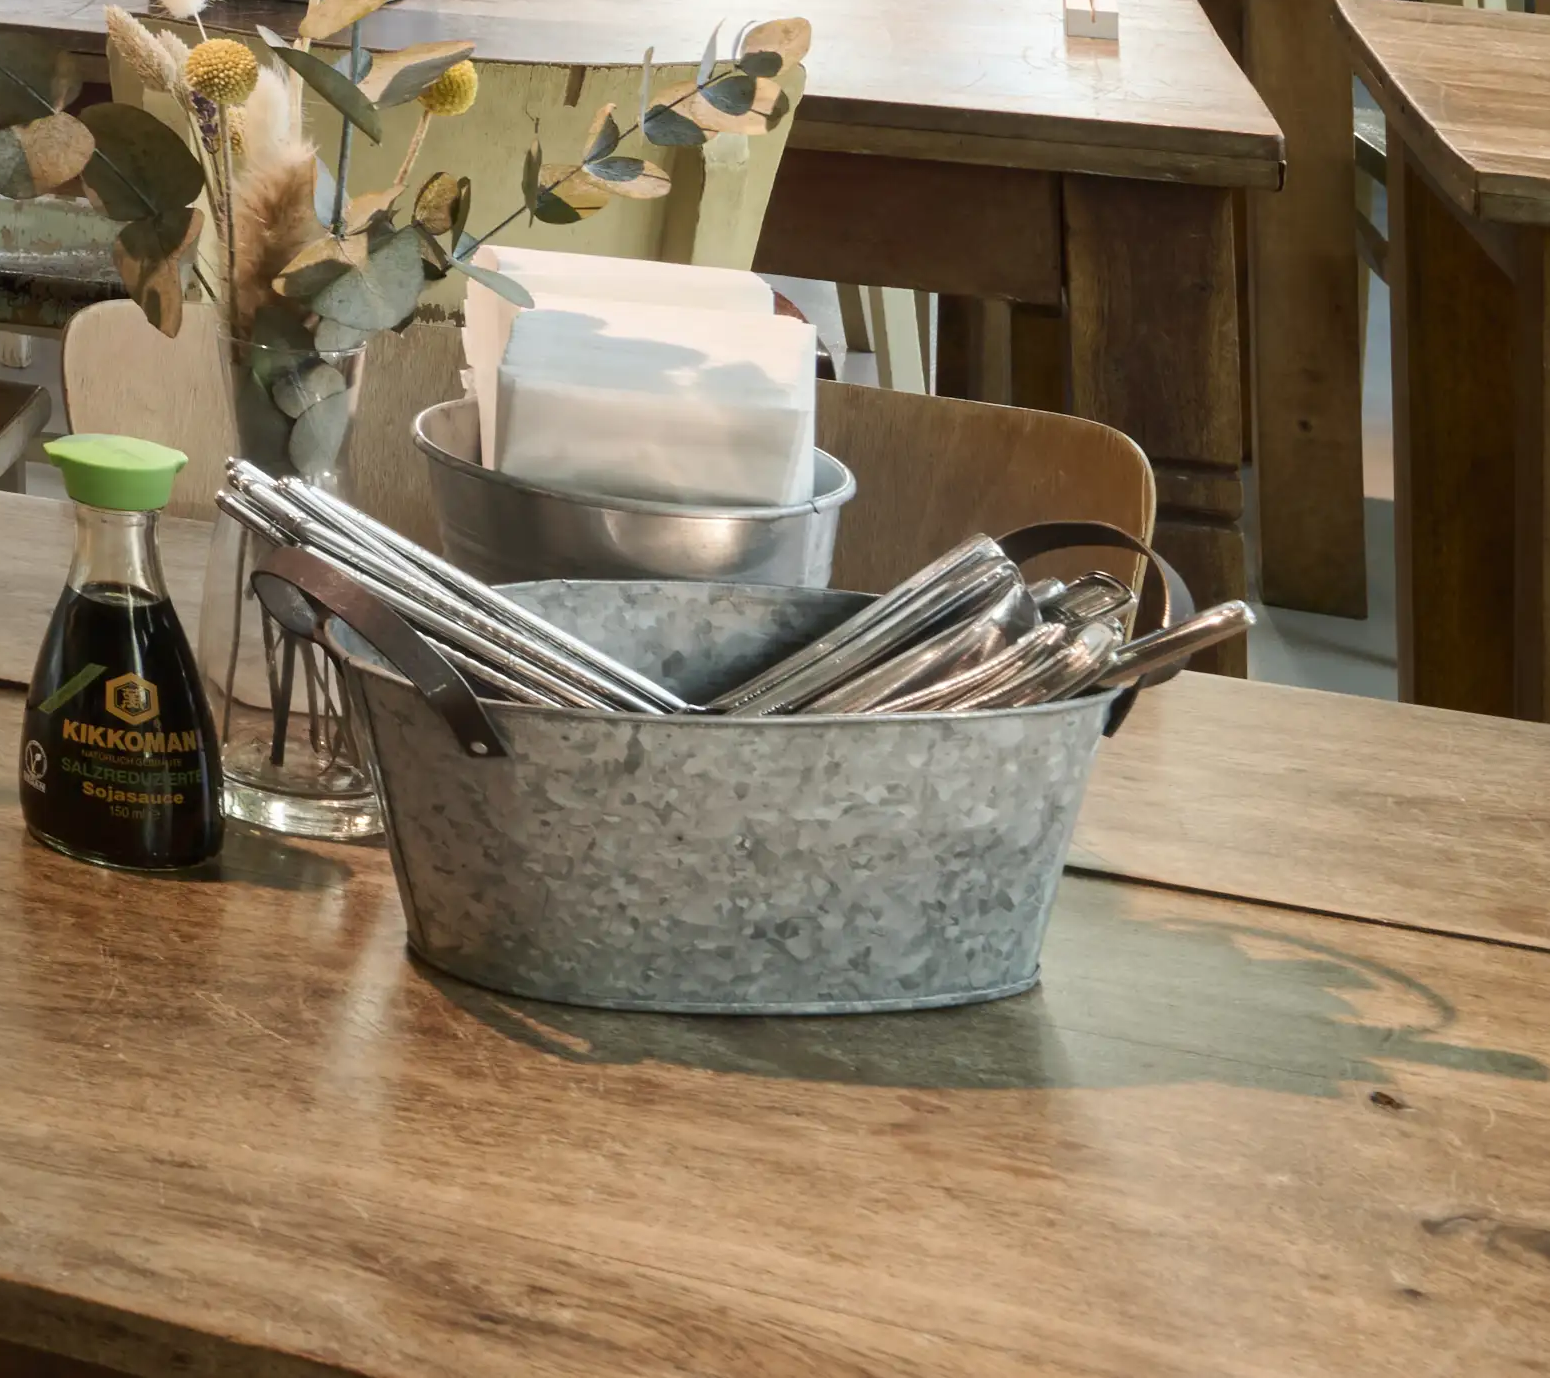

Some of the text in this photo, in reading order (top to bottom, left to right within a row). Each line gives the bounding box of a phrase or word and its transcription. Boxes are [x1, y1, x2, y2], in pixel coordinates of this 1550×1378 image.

[62, 718, 197, 753] KIKKOMAN
[61, 757, 203, 787] SALZREDUZIERTE
[82, 780, 185, 805] Sojasauce
[109, 804, 130, 818] 150
